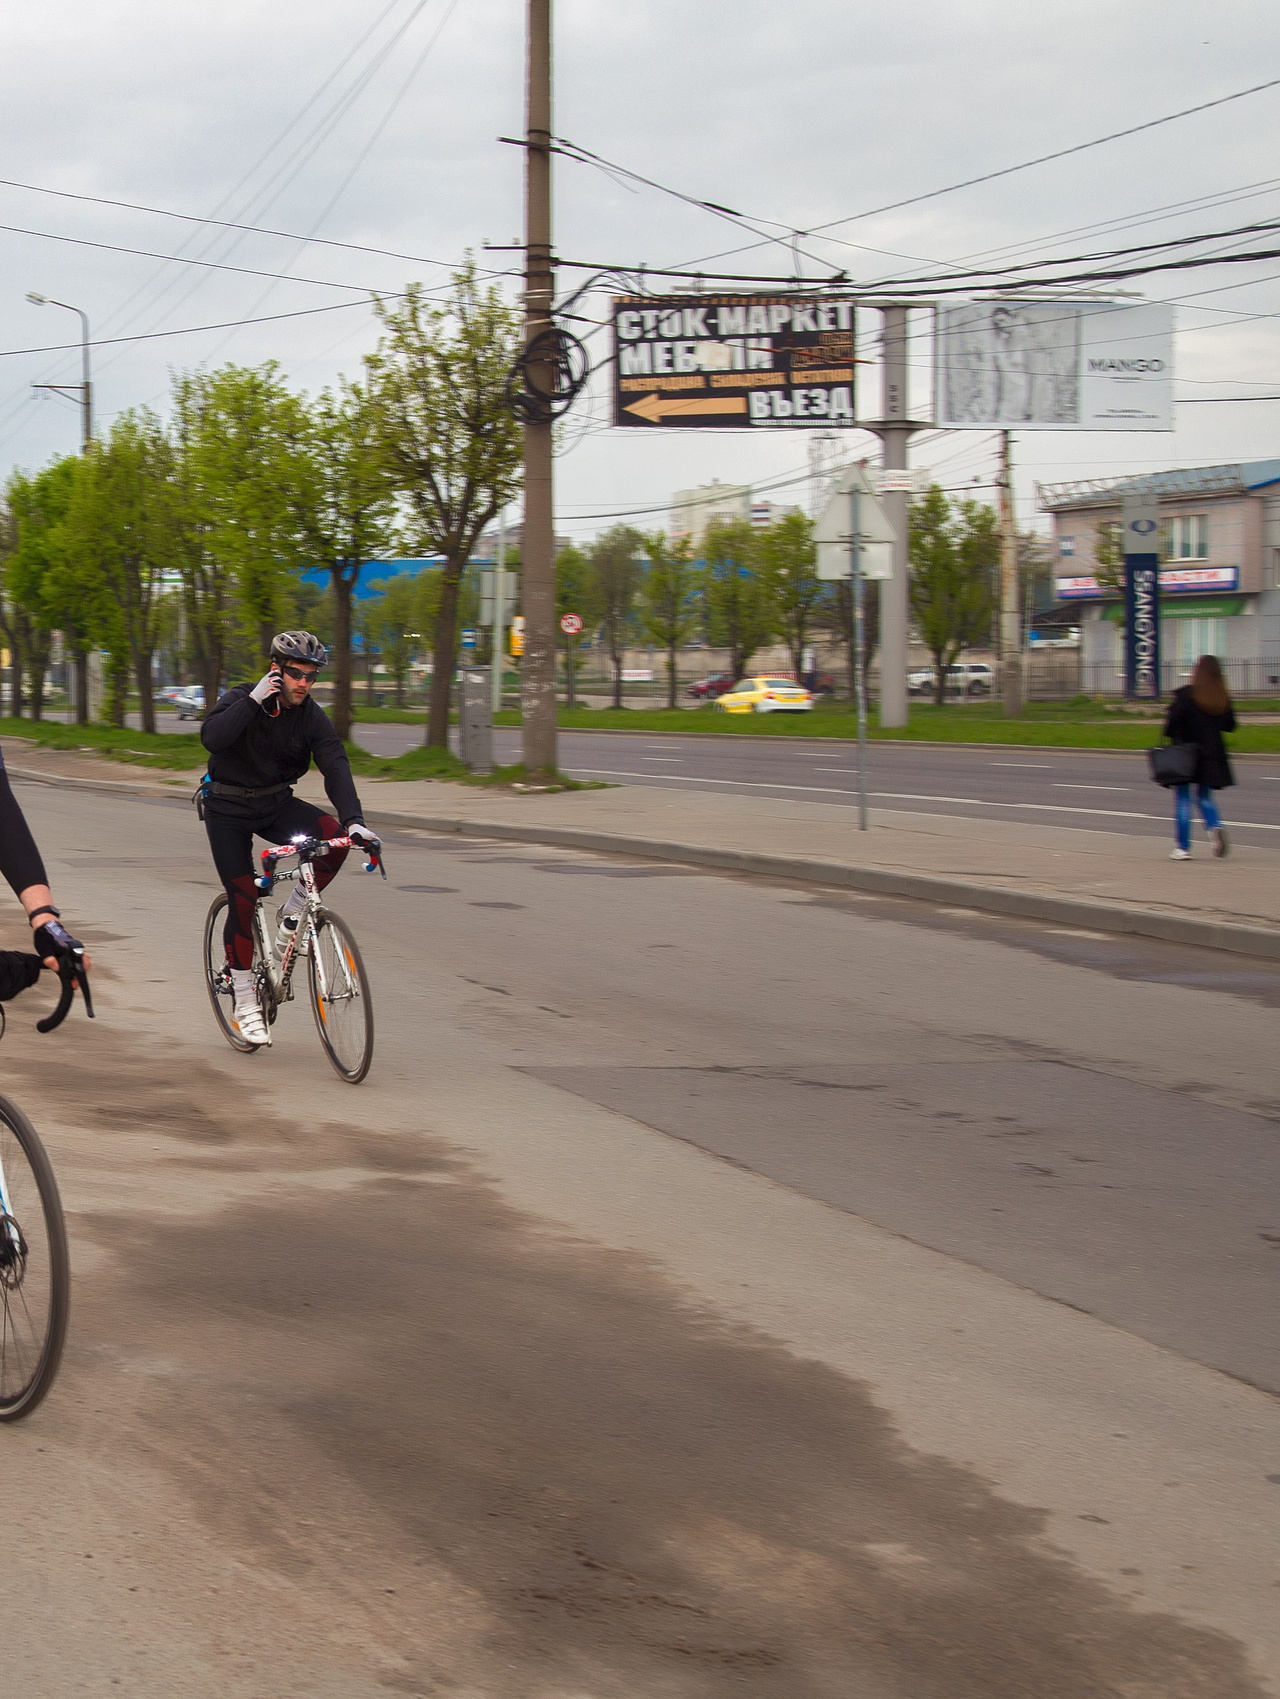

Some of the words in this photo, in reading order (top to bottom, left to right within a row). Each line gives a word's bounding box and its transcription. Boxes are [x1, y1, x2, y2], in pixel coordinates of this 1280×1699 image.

[616, 302, 854, 340] СТОК-МАРКЕТ
[1087, 358, 1165, 373] MANGO
[748, 387, 854, 419] ВЪЕЗД
[1133, 570, 1156, 682] SSANGYONG
[282, 947, 298, 986] GIANT
